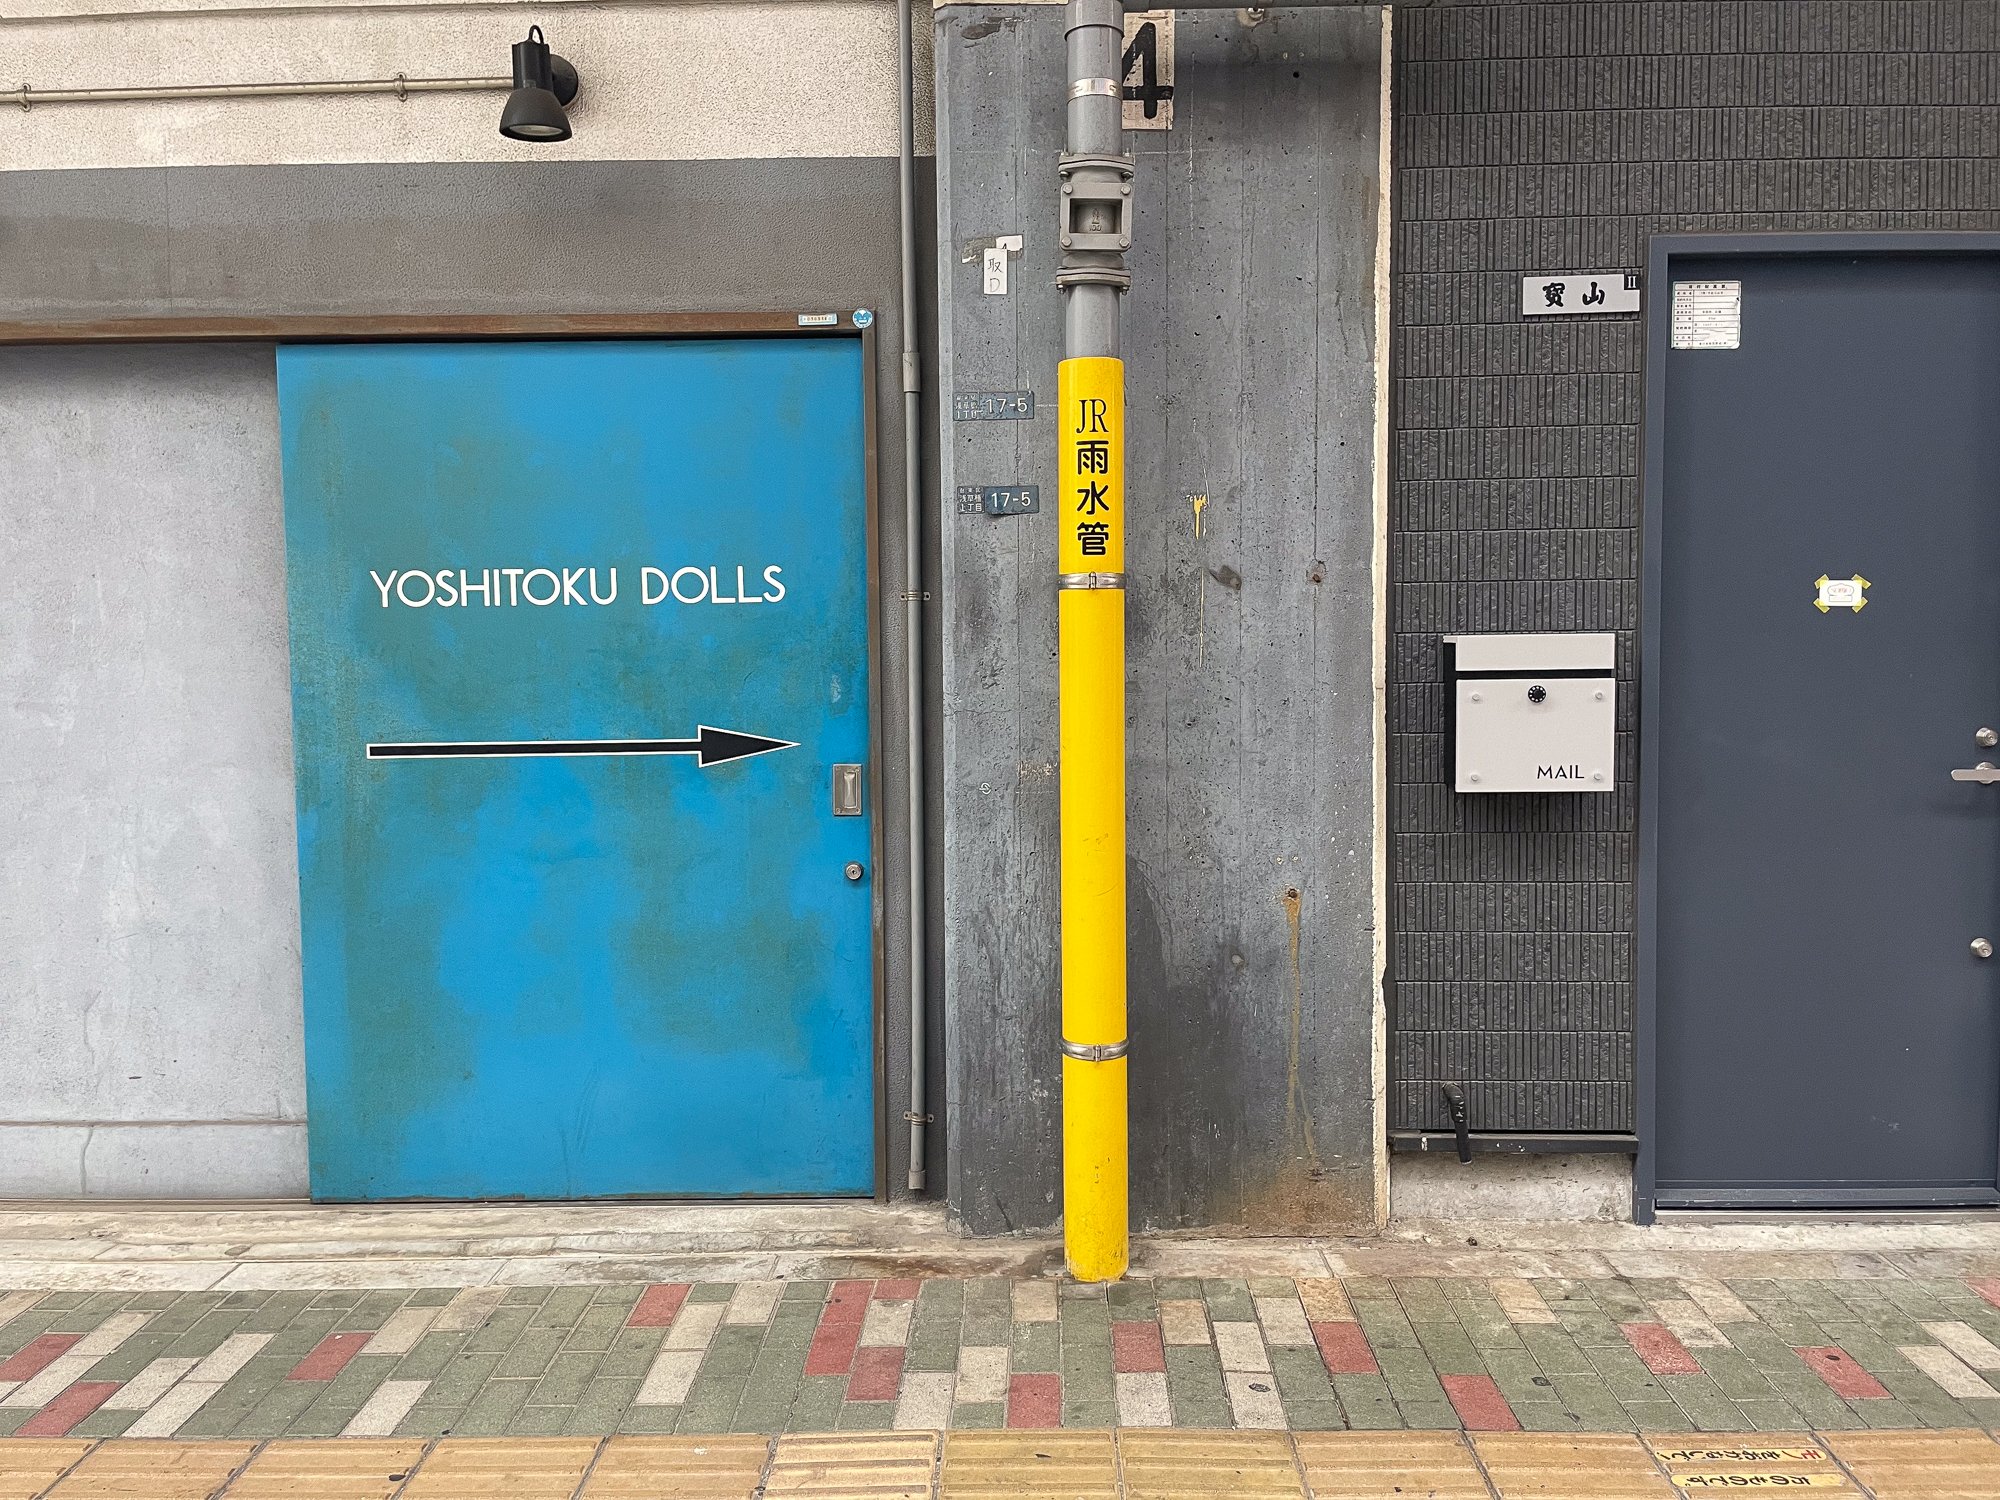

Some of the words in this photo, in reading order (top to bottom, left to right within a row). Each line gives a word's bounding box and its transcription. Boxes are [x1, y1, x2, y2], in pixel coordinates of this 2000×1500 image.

[1121, 21, 1174, 120] 4
[985, 397, 1029, 414] 17-5
[991, 491, 1031, 508] 17-5
[369, 566, 619, 608] YOSHITOKU
[640, 564, 787, 606] DOLLS
[1536, 764, 1585, 779] MAIL
